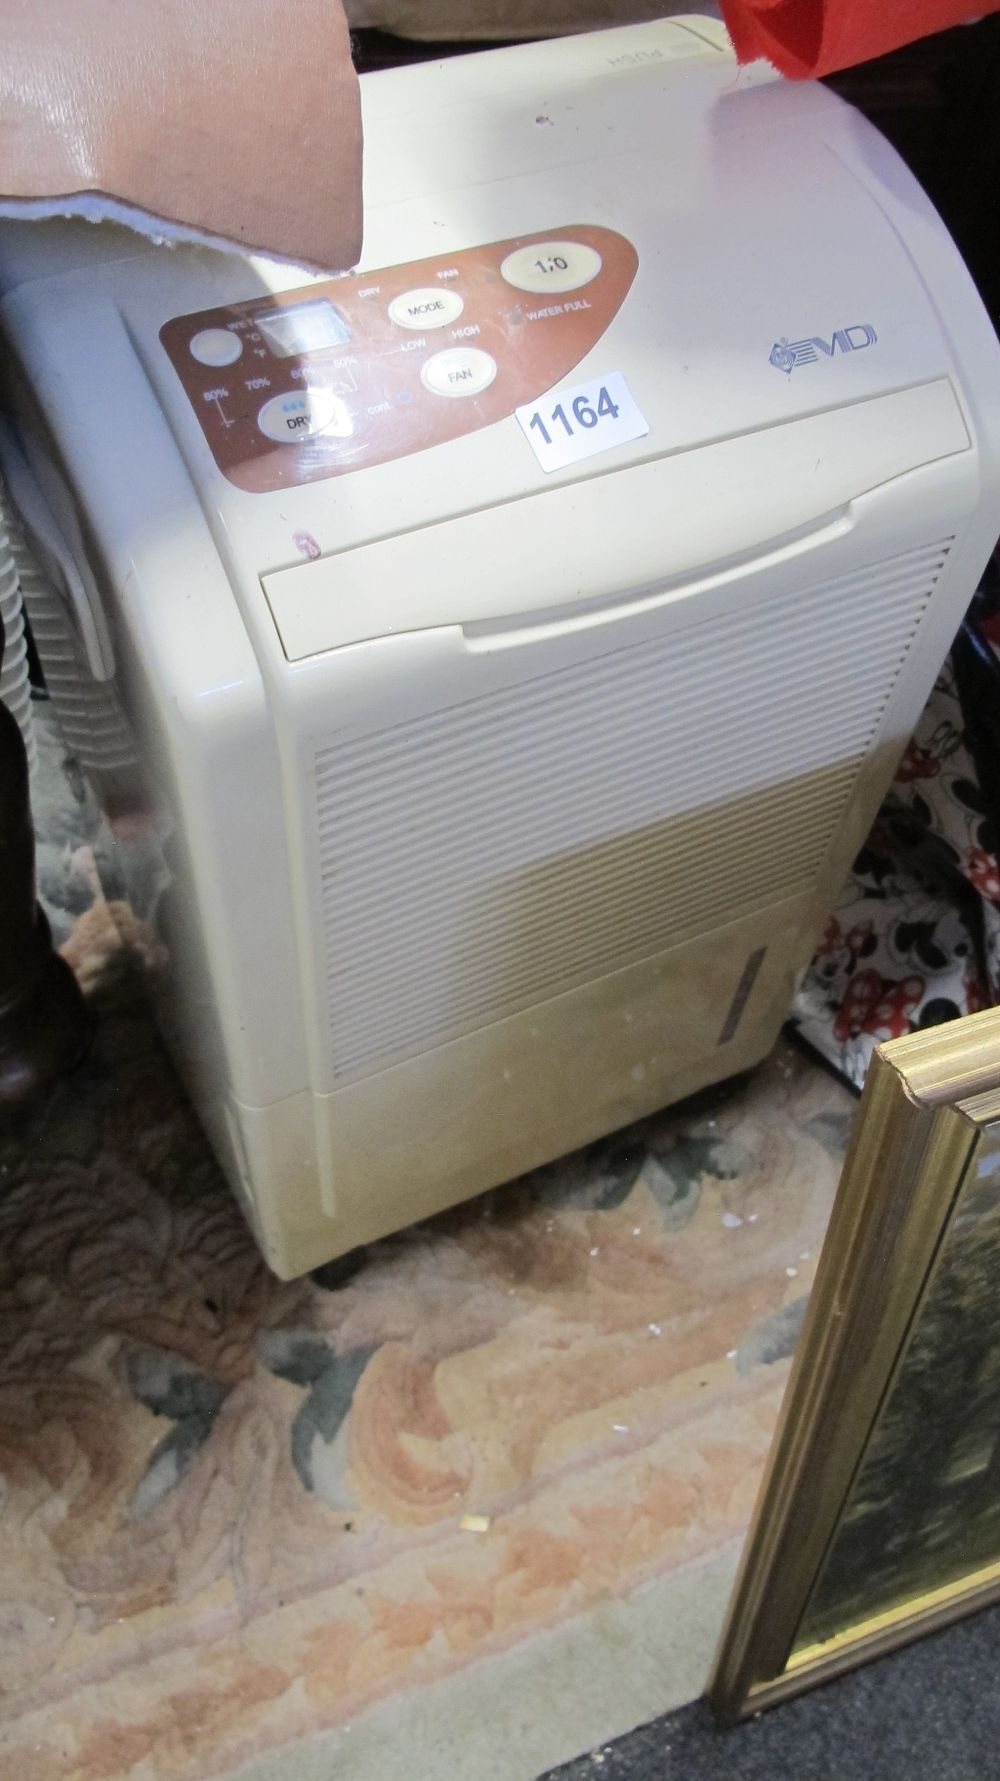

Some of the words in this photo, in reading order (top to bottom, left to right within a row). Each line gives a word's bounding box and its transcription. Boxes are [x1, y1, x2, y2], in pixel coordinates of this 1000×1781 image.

[358, 286, 381, 299] DRY
[408, 301, 445, 316] MODE
[526, 306, 562, 321] WATER
[565, 299, 592, 313] FULL
[452, 325, 480, 339] HIGH
[400, 338, 426, 351] LOW
[448, 367, 473, 382] FAN
[529, 386, 620, 445] 1164
